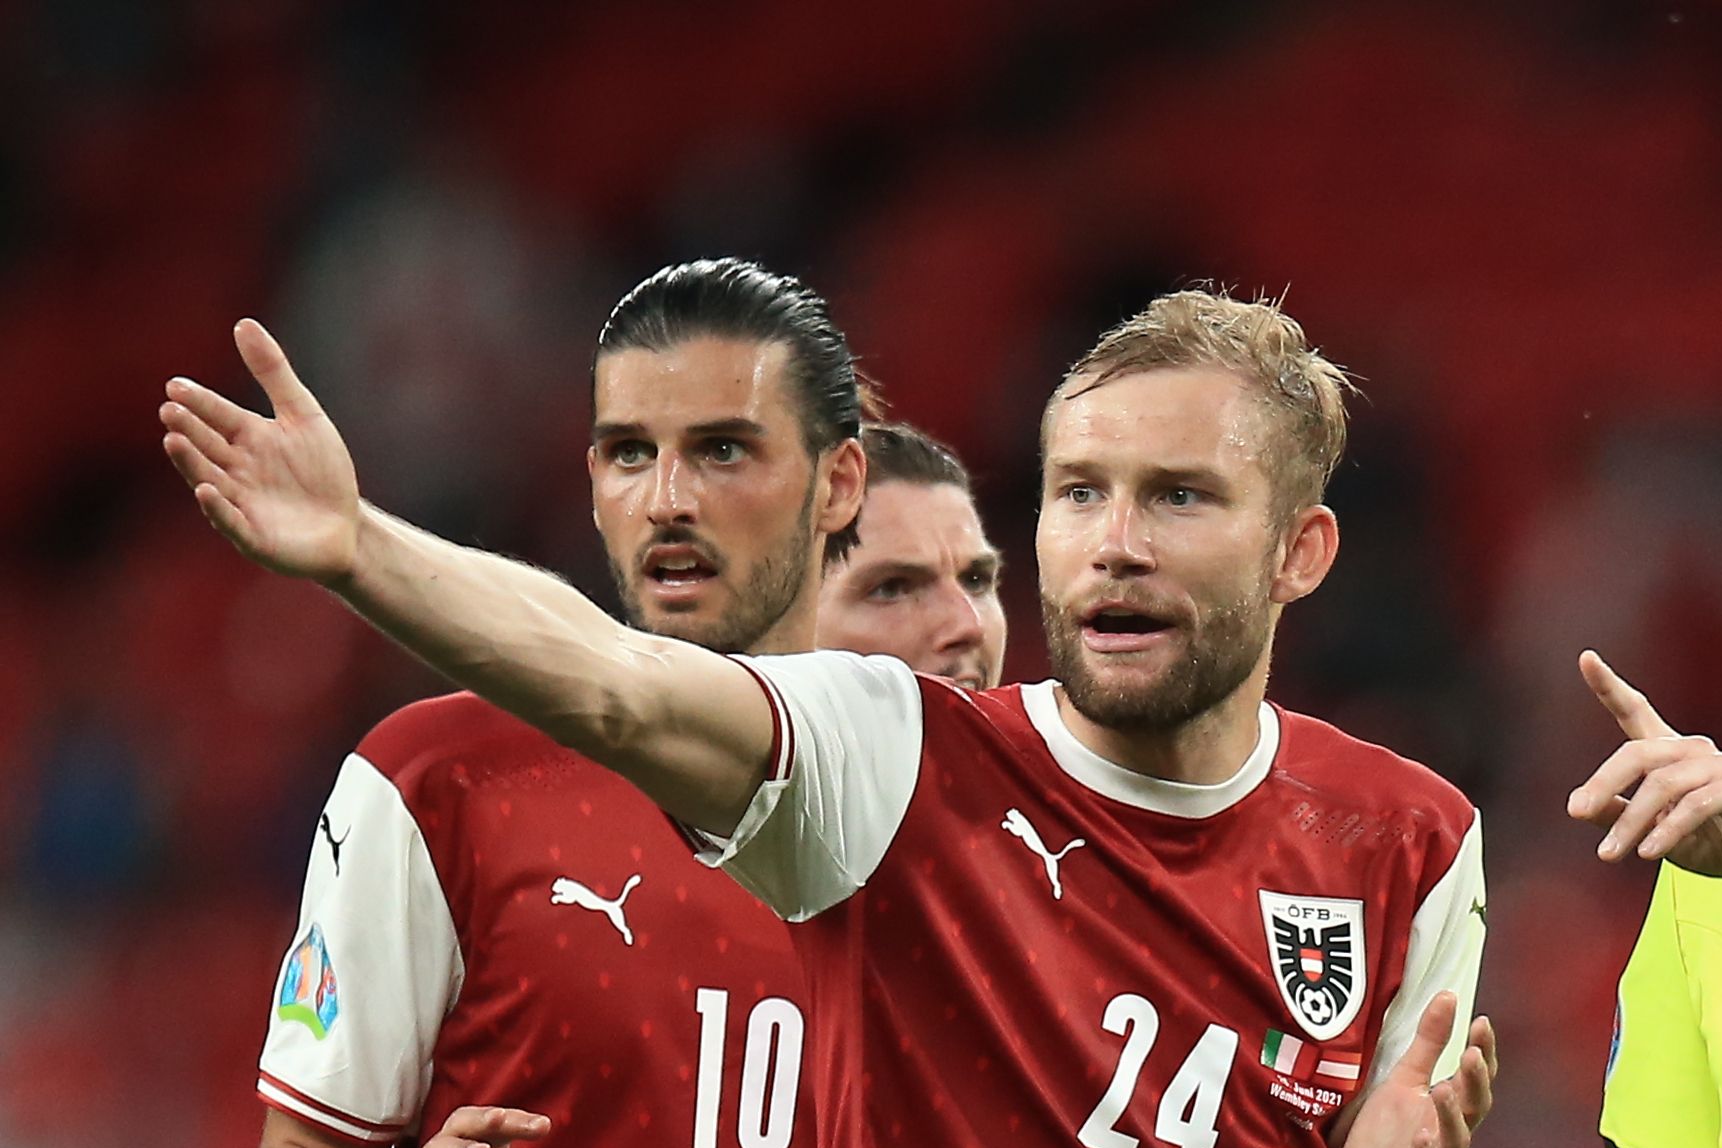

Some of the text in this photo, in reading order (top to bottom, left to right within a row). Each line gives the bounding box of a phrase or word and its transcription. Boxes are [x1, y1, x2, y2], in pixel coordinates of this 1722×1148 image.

[1287, 903, 1331, 921] ÖFB
[1269, 1082, 1311, 1115] Wembley
[1293, 1081, 1314, 1099] Juni
[1315, 1088, 1342, 1107] 2021
